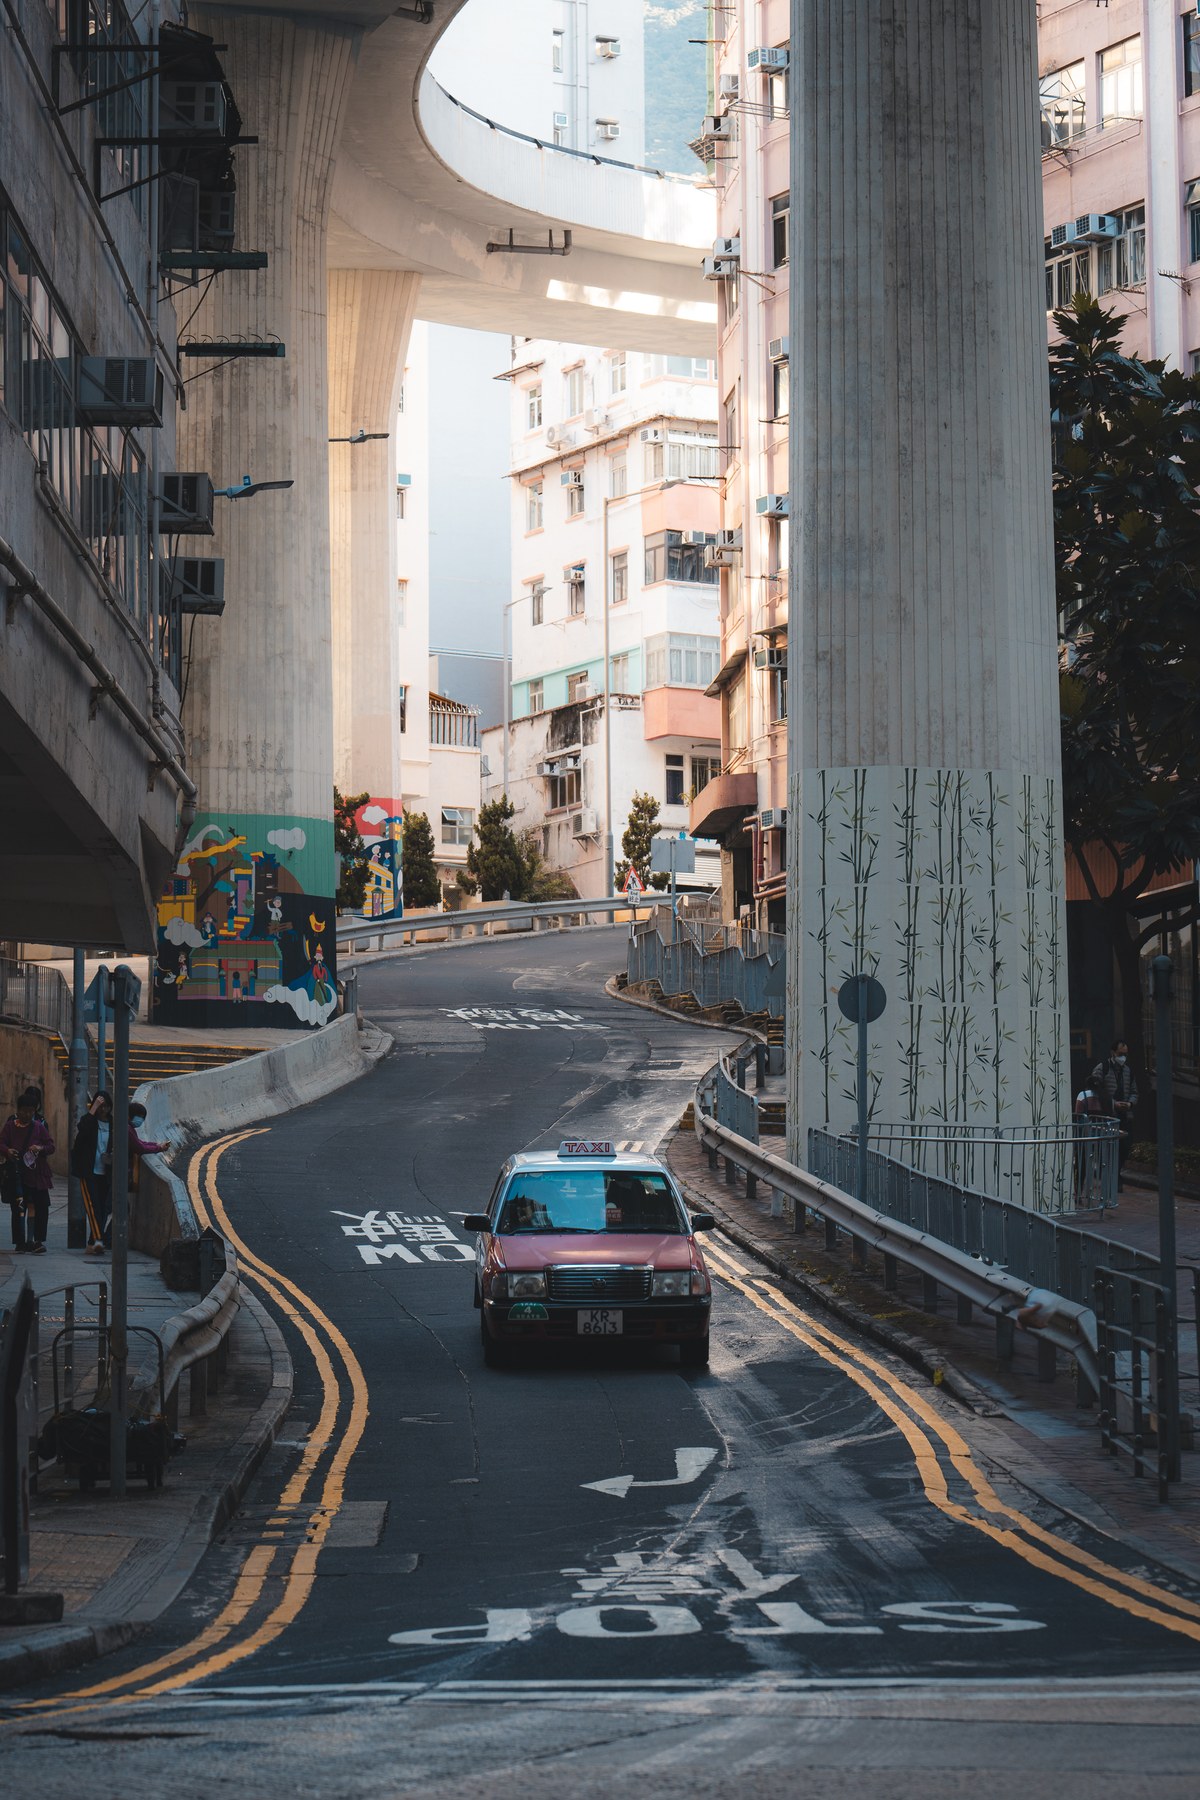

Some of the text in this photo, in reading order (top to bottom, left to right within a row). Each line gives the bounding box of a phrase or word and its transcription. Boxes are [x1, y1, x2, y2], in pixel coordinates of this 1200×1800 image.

[438, 1007, 584, 1022] 慢駛
[466, 1021, 611, 1030] SLOW
[564, 1142, 610, 1153] TAXI
[330, 1210, 472, 1243] 駛
[356, 1243, 476, 1265] OW
[523, 1306, 532, 1314] 4
[590, 1311, 610, 1322] KR
[583, 1322, 618, 1334] 8613
[388, 1600, 1048, 1646] STOP
